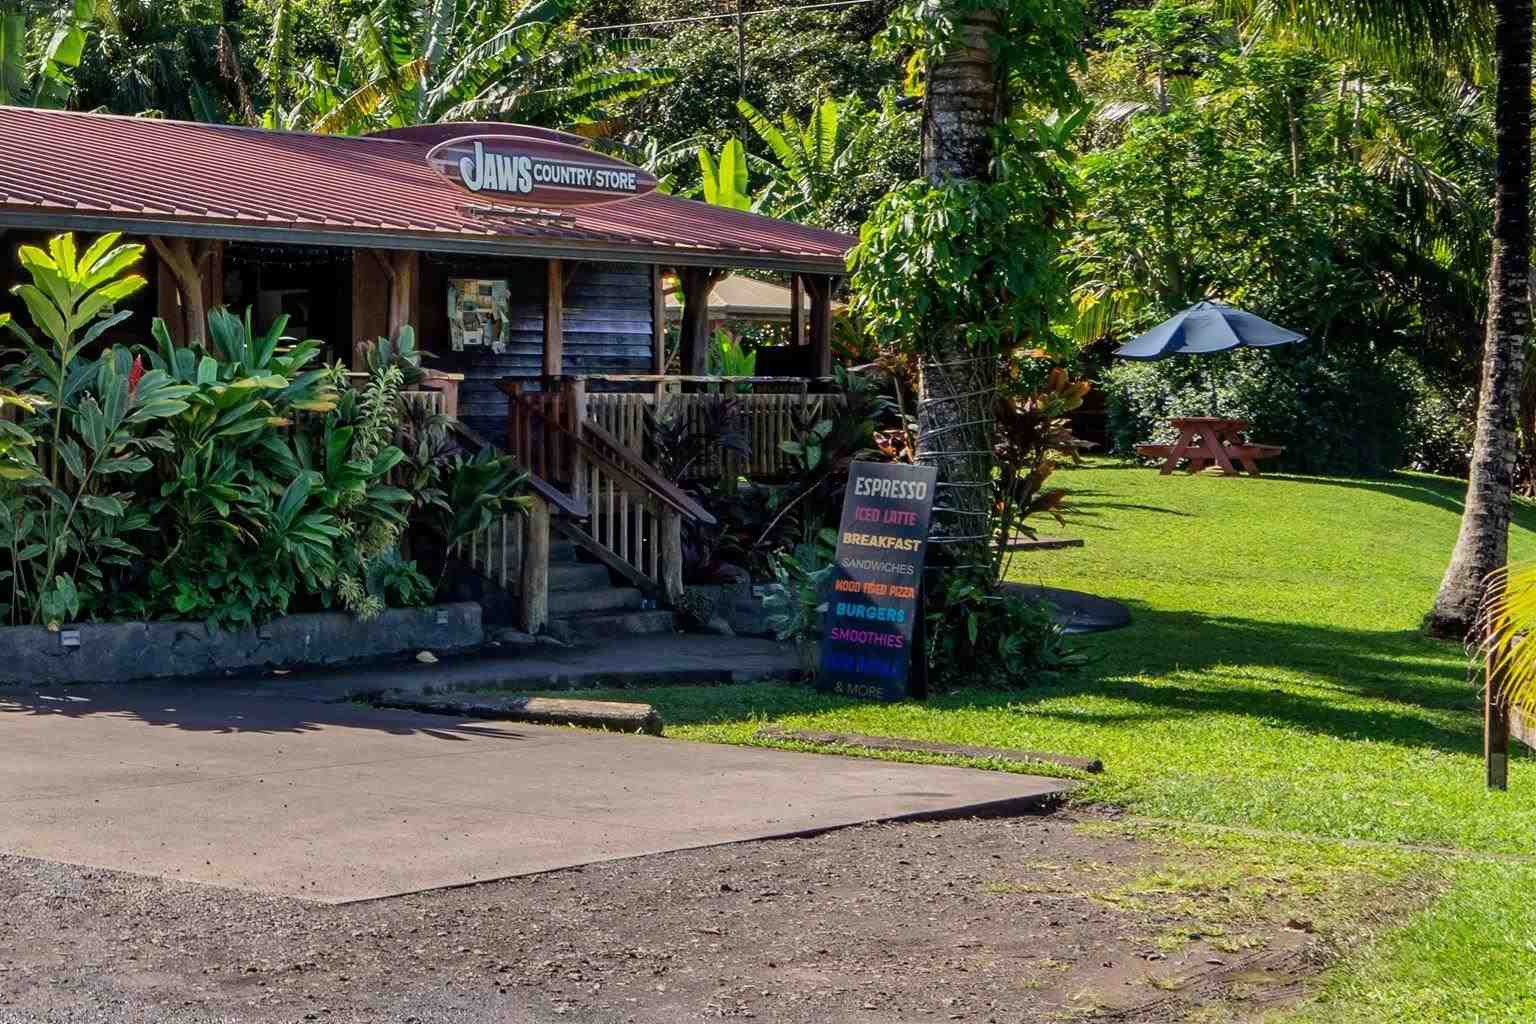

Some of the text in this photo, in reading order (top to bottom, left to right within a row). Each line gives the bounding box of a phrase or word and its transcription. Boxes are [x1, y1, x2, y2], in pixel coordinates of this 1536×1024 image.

[460, 141, 637, 193] JAWS COUNTRY STORE
[854, 477, 928, 500] ESPRESSO
[855, 506, 919, 526] ICED LATTE
[843, 532, 922, 552] BREAKFAST
[841, 558, 914, 576] SANDWICHES
[836, 602, 905, 623] BURGERS
[832, 627, 904, 648] SMOOTHIES
